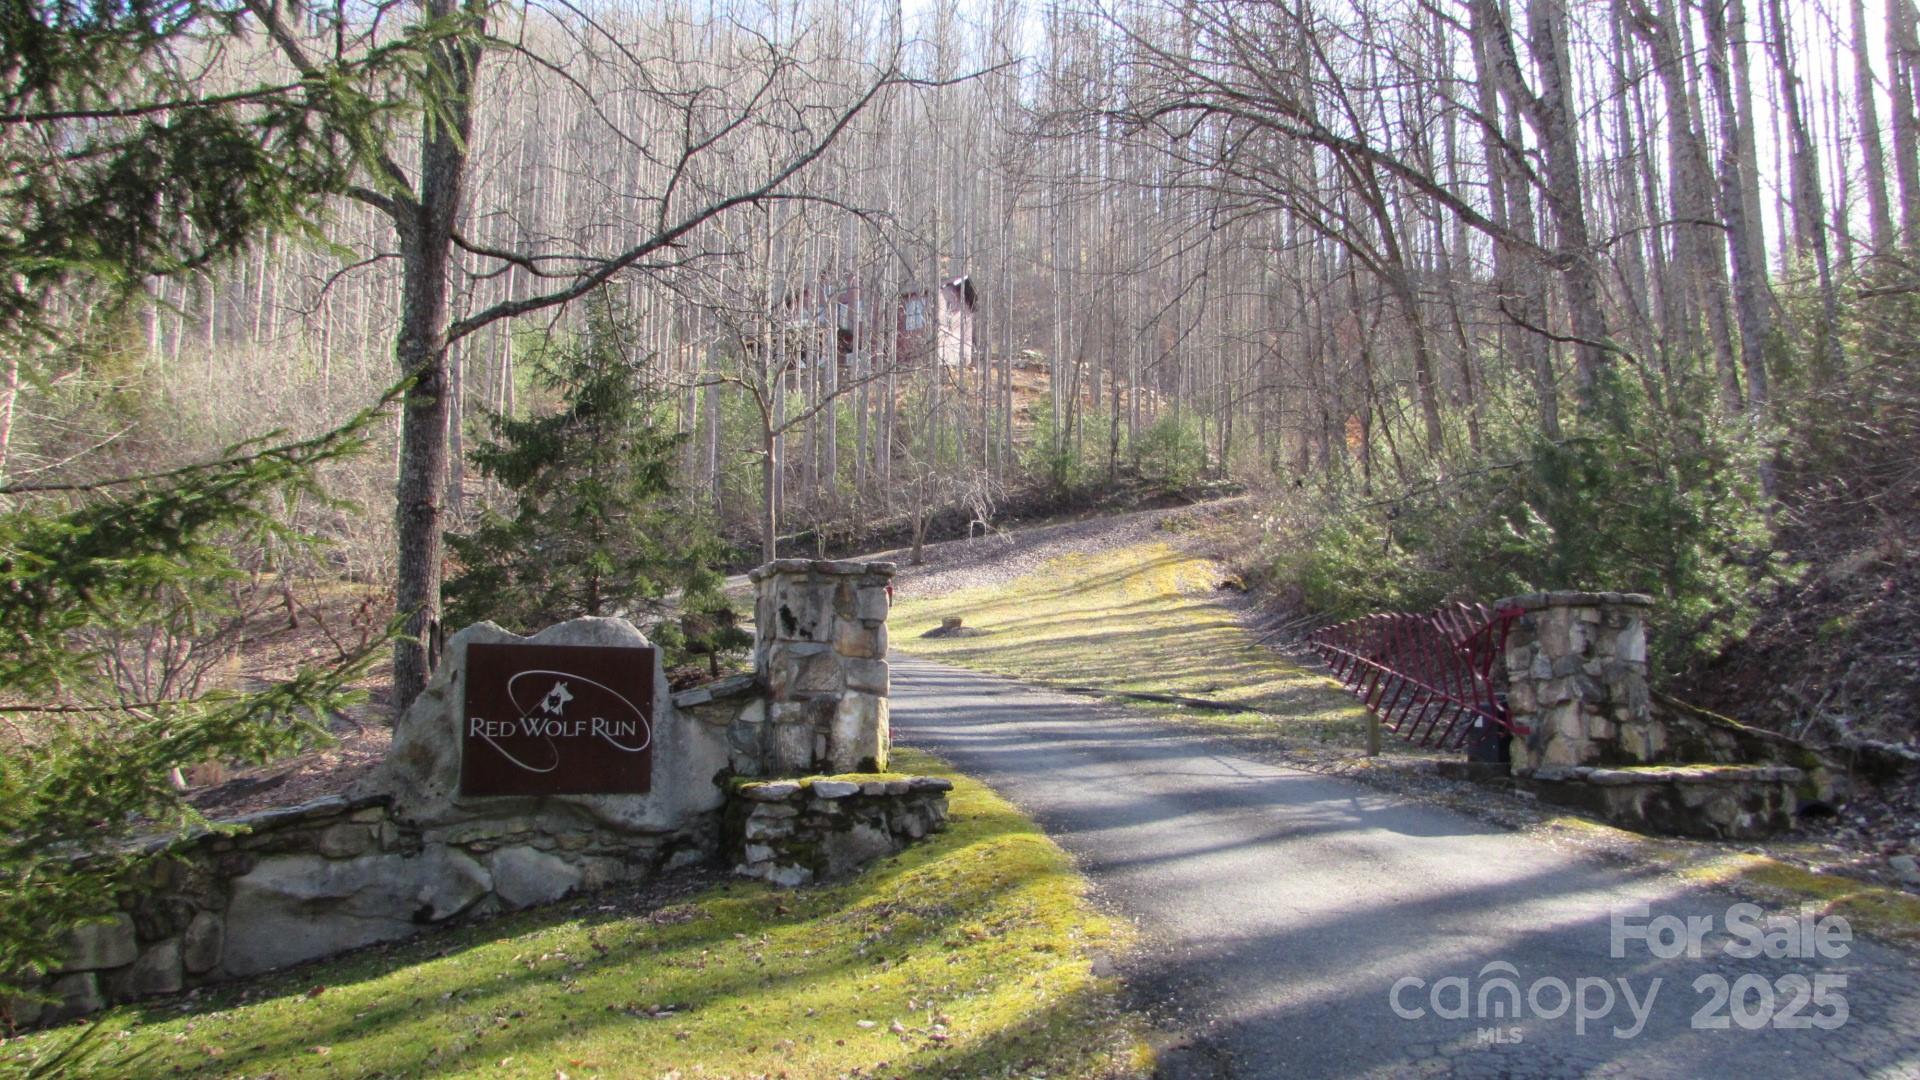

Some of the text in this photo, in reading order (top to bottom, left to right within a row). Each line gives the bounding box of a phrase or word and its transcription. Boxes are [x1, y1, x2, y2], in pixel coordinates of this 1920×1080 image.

[469, 717, 636, 737] RED WOLF RUN
